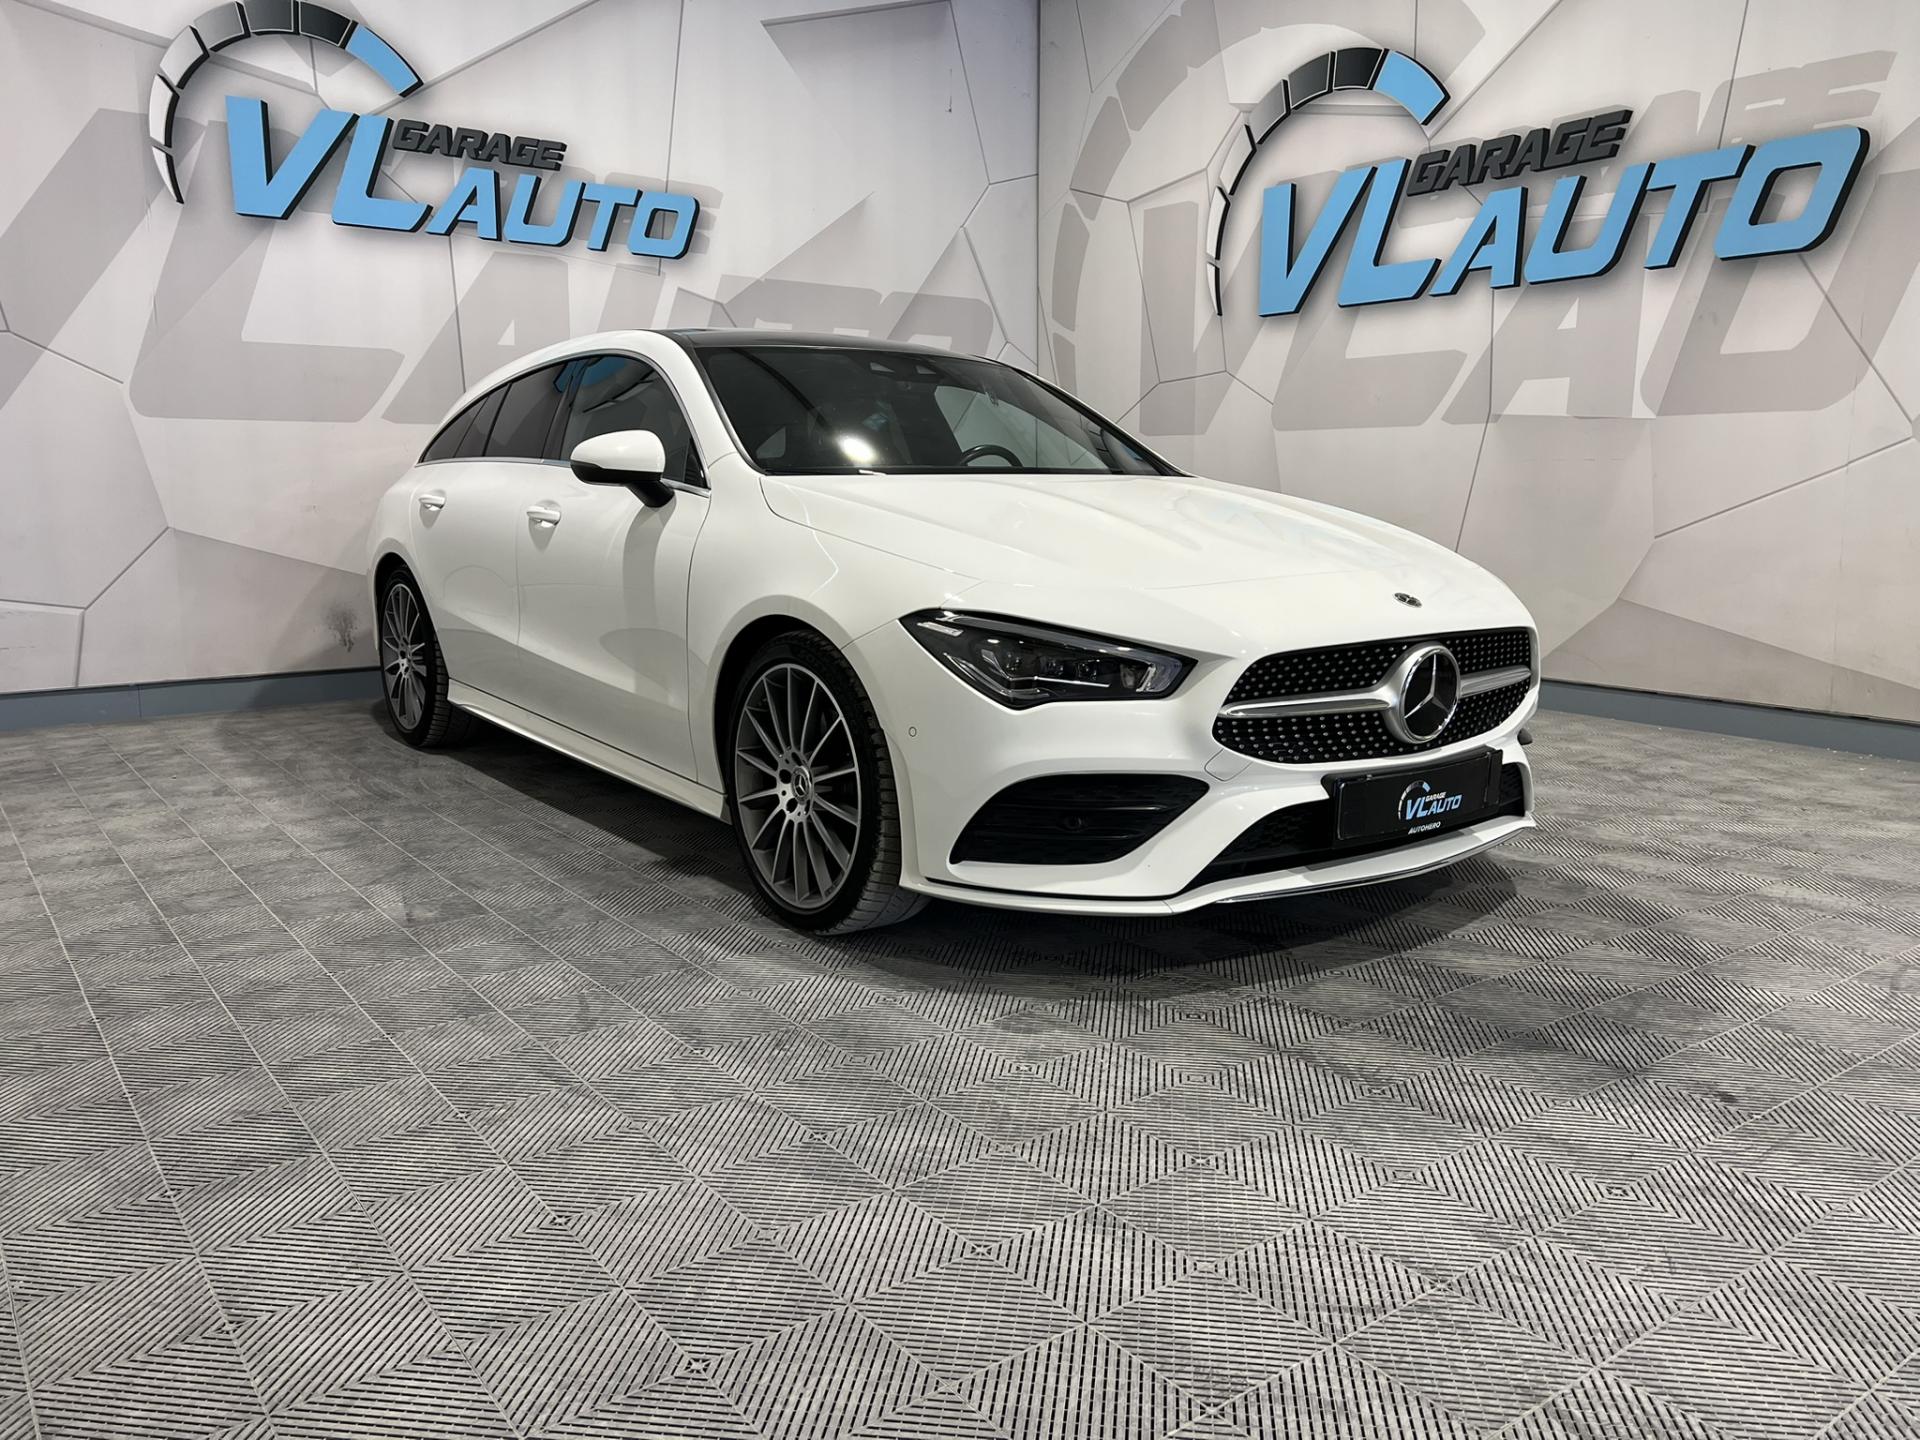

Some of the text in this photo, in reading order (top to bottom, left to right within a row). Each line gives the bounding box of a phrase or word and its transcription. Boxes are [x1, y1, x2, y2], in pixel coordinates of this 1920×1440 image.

[392, 118, 568, 172] GARAGE
[1406, 108, 1633, 197] GARAGE
[1425, 791, 1447, 802] GARAGE
[1408, 821, 1441, 835] AUTOHERO
